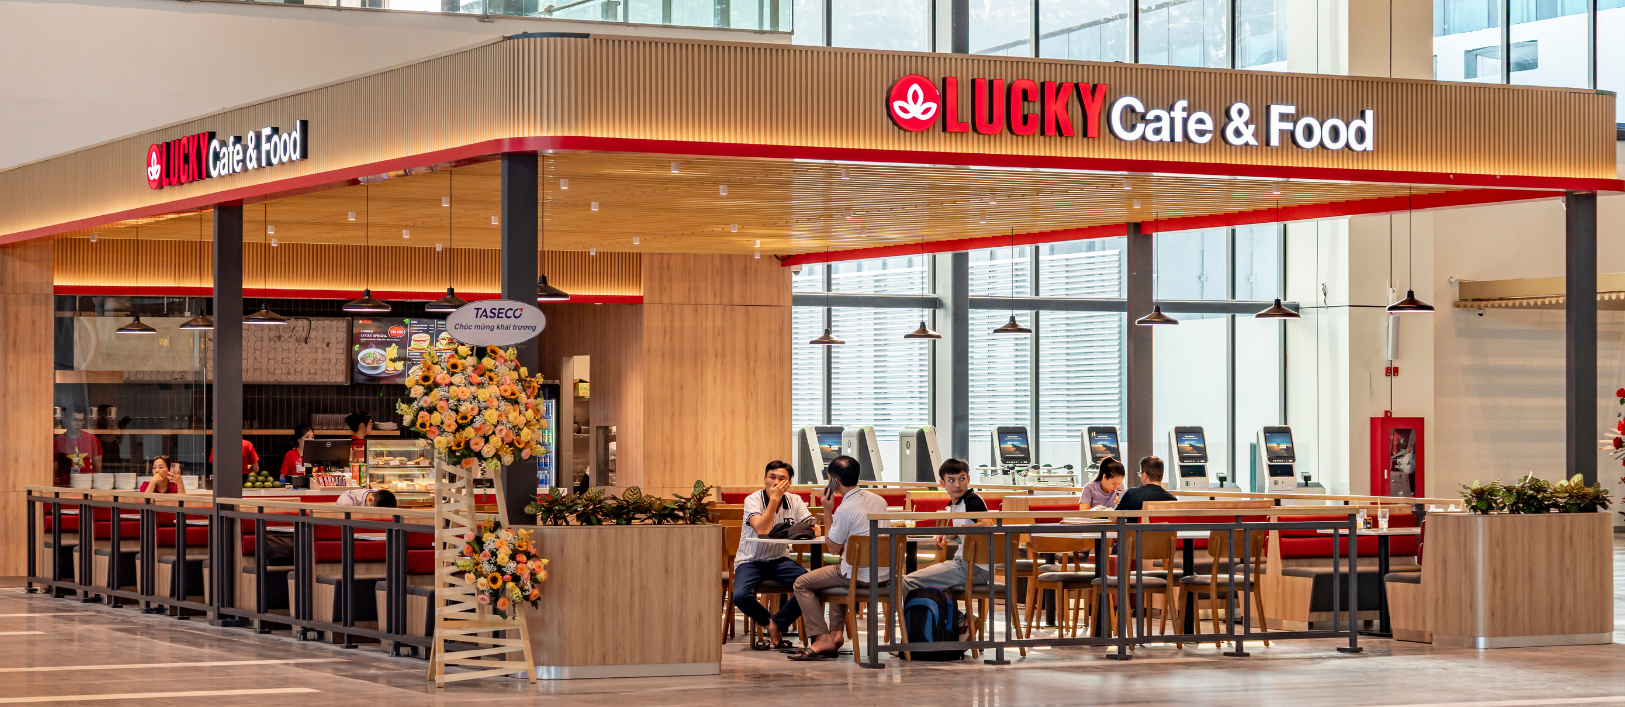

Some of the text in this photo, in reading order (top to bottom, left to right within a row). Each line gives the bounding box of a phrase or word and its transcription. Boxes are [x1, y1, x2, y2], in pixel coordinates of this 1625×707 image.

[945, 76, 1374, 152] LUCKY Cafe & Food
[161, 119, 300, 187] LUCKY Cafe & Food
[454, 323, 473, 331] Chúc
[496, 323, 511, 331] khai
[474, 307, 523, 319] TASECO
